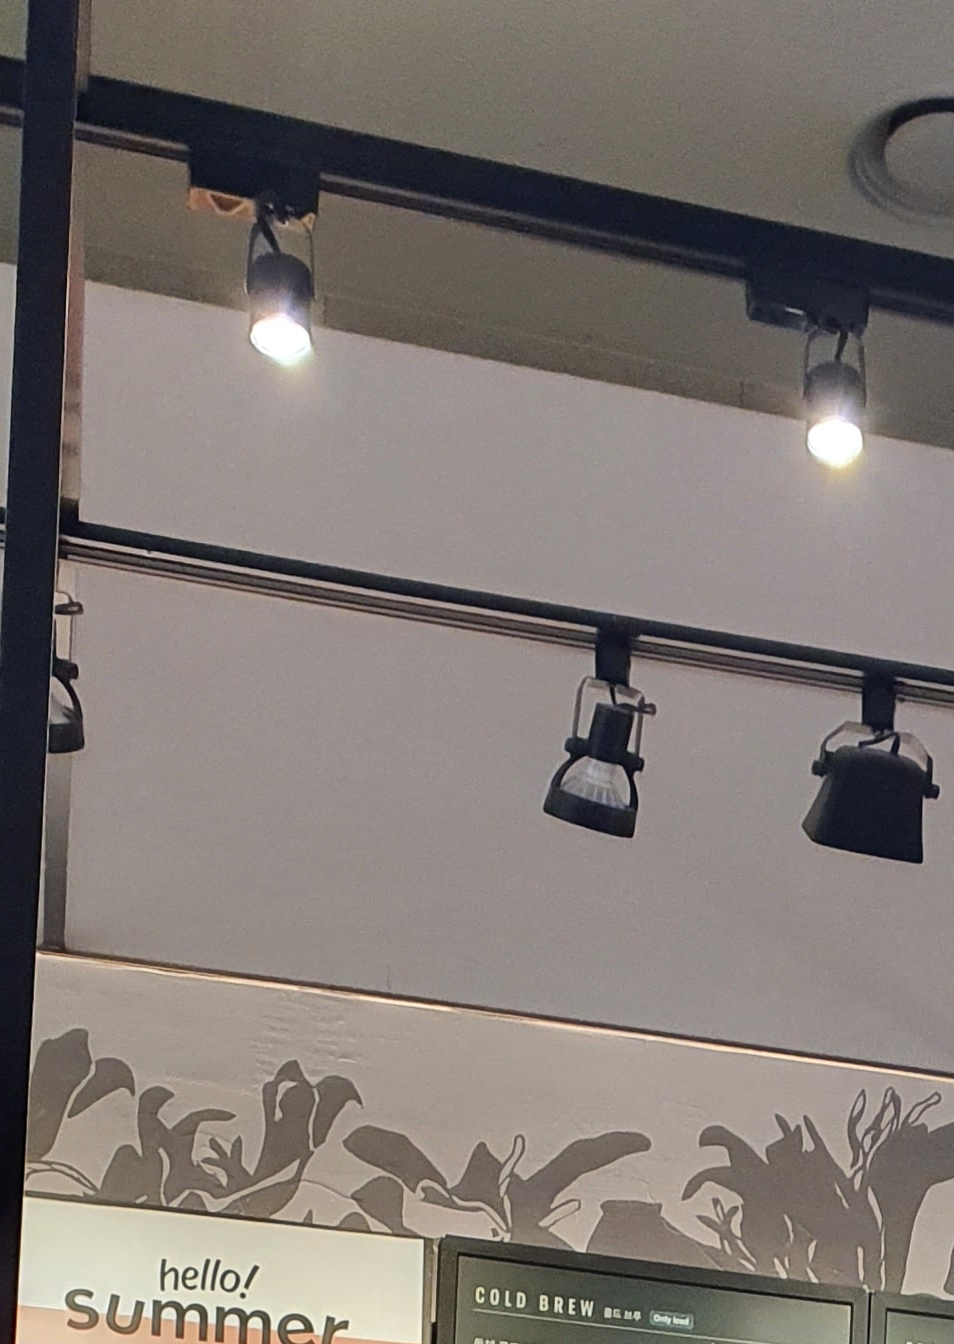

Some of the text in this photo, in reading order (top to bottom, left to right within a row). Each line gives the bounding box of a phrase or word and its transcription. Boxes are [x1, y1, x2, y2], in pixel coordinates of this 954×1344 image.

[160, 1258, 259, 1298] hello!
[475, 1286, 525, 1308] COLD
[539, 1294, 593, 1317] BREW
